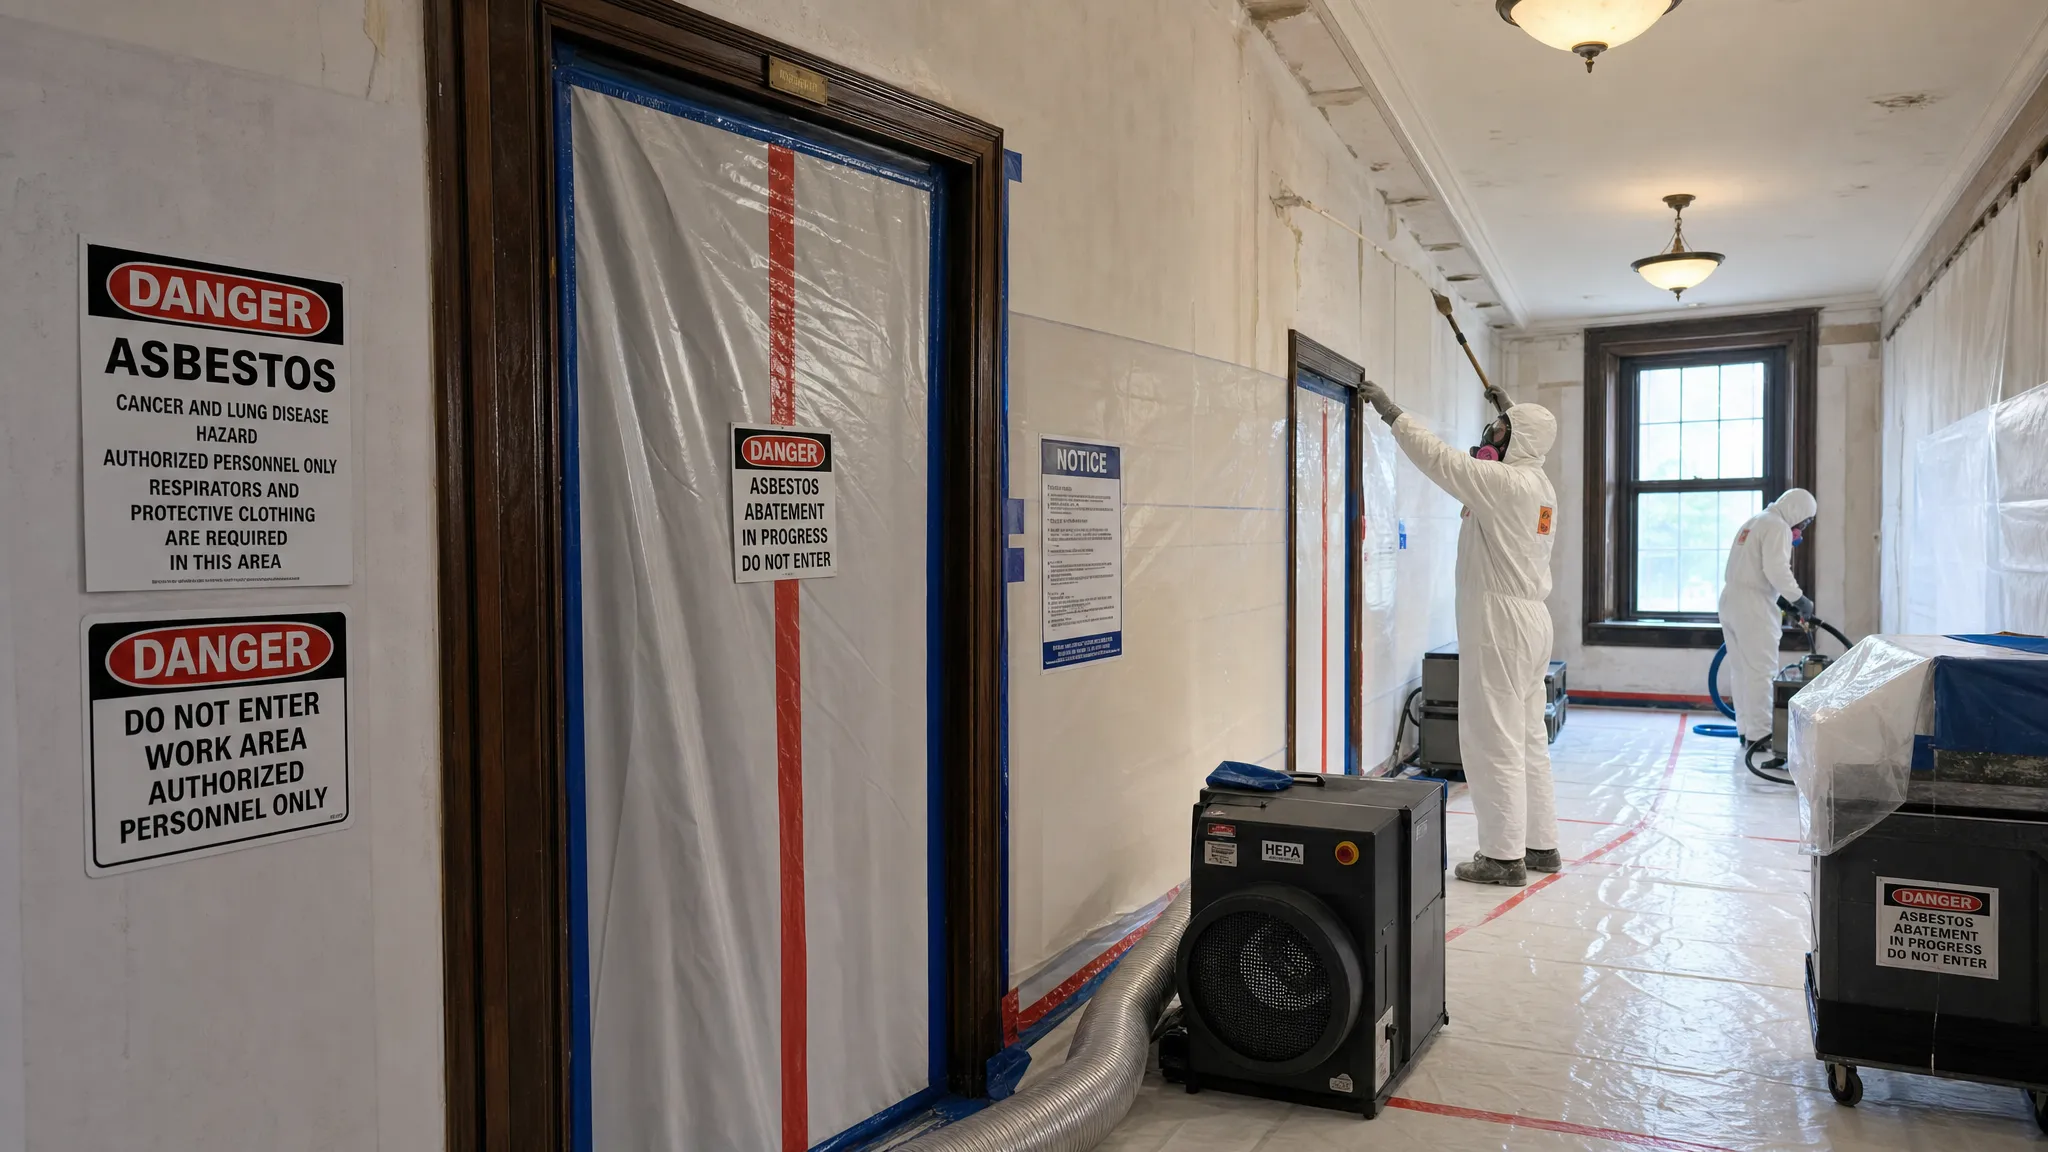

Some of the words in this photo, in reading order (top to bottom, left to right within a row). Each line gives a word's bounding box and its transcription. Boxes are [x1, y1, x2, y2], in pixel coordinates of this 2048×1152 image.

[128, 270, 312, 329] DANGER
[104, 338, 336, 393] ASBESTOS
[116, 394, 183, 415] CANCER
[189, 400, 222, 416] AND
[227, 402, 267, 420] LUNG
[272, 405, 329, 424] DISEASE
[196, 425, 257, 444] HAZARD
[751, 440, 818, 463] DANGER
[1057, 448, 1107, 473] NOTICE
[104, 449, 208, 469] AUTHORIZED
[214, 454, 299, 473] PERSONNEL
[304, 458, 337, 474] ONLY
[149, 479, 262, 498] RESPIRATORS
[267, 482, 299, 498] AND
[750, 477, 819, 495] ASBESTOS
[131, 505, 233, 522] PROTECTIVE
[239, 506, 315, 522] CLOTHING
[745, 503, 824, 520] ABATEMENT
[165, 530, 200, 546] ARE
[206, 530, 287, 546] REQUIRED
[743, 529, 756, 546] IN
[762, 528, 827, 545] PROGRESS
[170, 555, 188, 570] IN
[193, 555, 232, 570] THIS
[238, 554, 282, 569] AREA
[743, 555, 760, 571] DO
[765, 554, 790, 570] NOT
[794, 552, 831, 568] ENTER
[134, 631, 311, 679] DANGER
[125, 707, 164, 736] DO
[175, 700, 230, 730] NOT
[240, 692, 320, 723] ENTER
[146, 736, 232, 770] WORK
[240, 727, 307, 758] AREA
[148, 761, 304, 805] AUTHORIZED
[120, 798, 266, 844] PERSONNEL
[273, 787, 328, 815] ONLY
[1265, 844, 1300, 858] HEPA
[1902, 891, 1971, 909] DANGER
[1900, 911, 1973, 927] ASBESTOS
[1894, 924, 1978, 941] ABATEMENT
[1890, 936, 1903, 946] IN
[1909, 938, 1981, 954] PROGRESS
[1888, 949, 1906, 959] DO
[1912, 951, 1938, 962] NOT
[1943, 955, 1987, 968] ENTER
